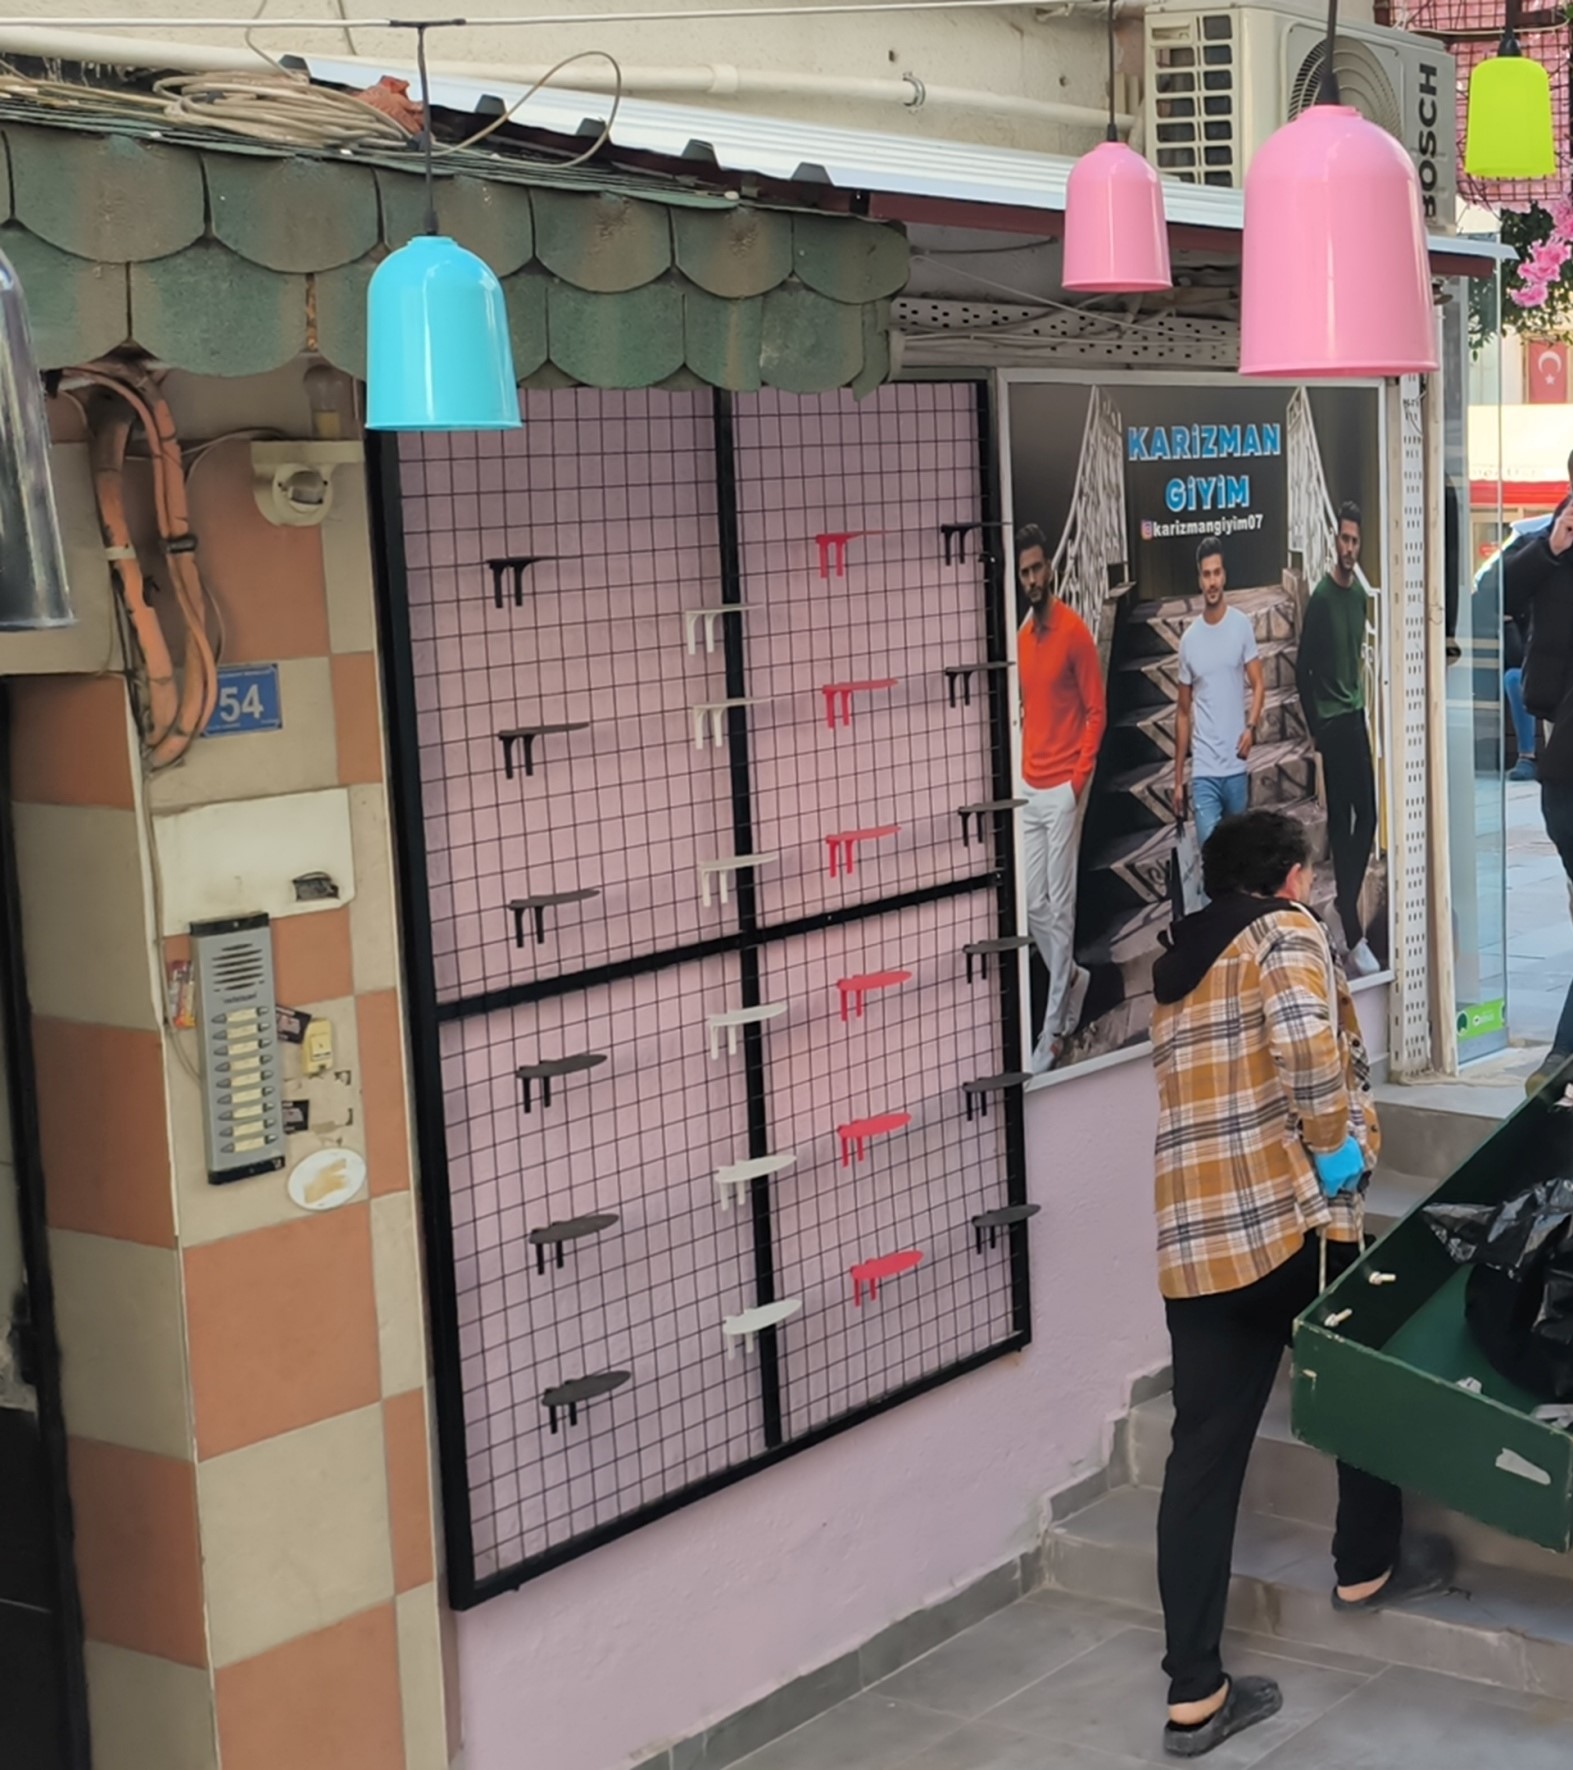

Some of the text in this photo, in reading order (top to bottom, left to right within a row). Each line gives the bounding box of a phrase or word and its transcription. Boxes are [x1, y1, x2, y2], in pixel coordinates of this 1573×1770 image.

[1418, 63, 1437, 218] BOSCH
[1128, 422, 1281, 462] KARİZMAN
[1165, 474, 1250, 513] GİYİM
[1153, 514, 1264, 538] karizmangiyim07
[219, 684, 265, 722] 54
